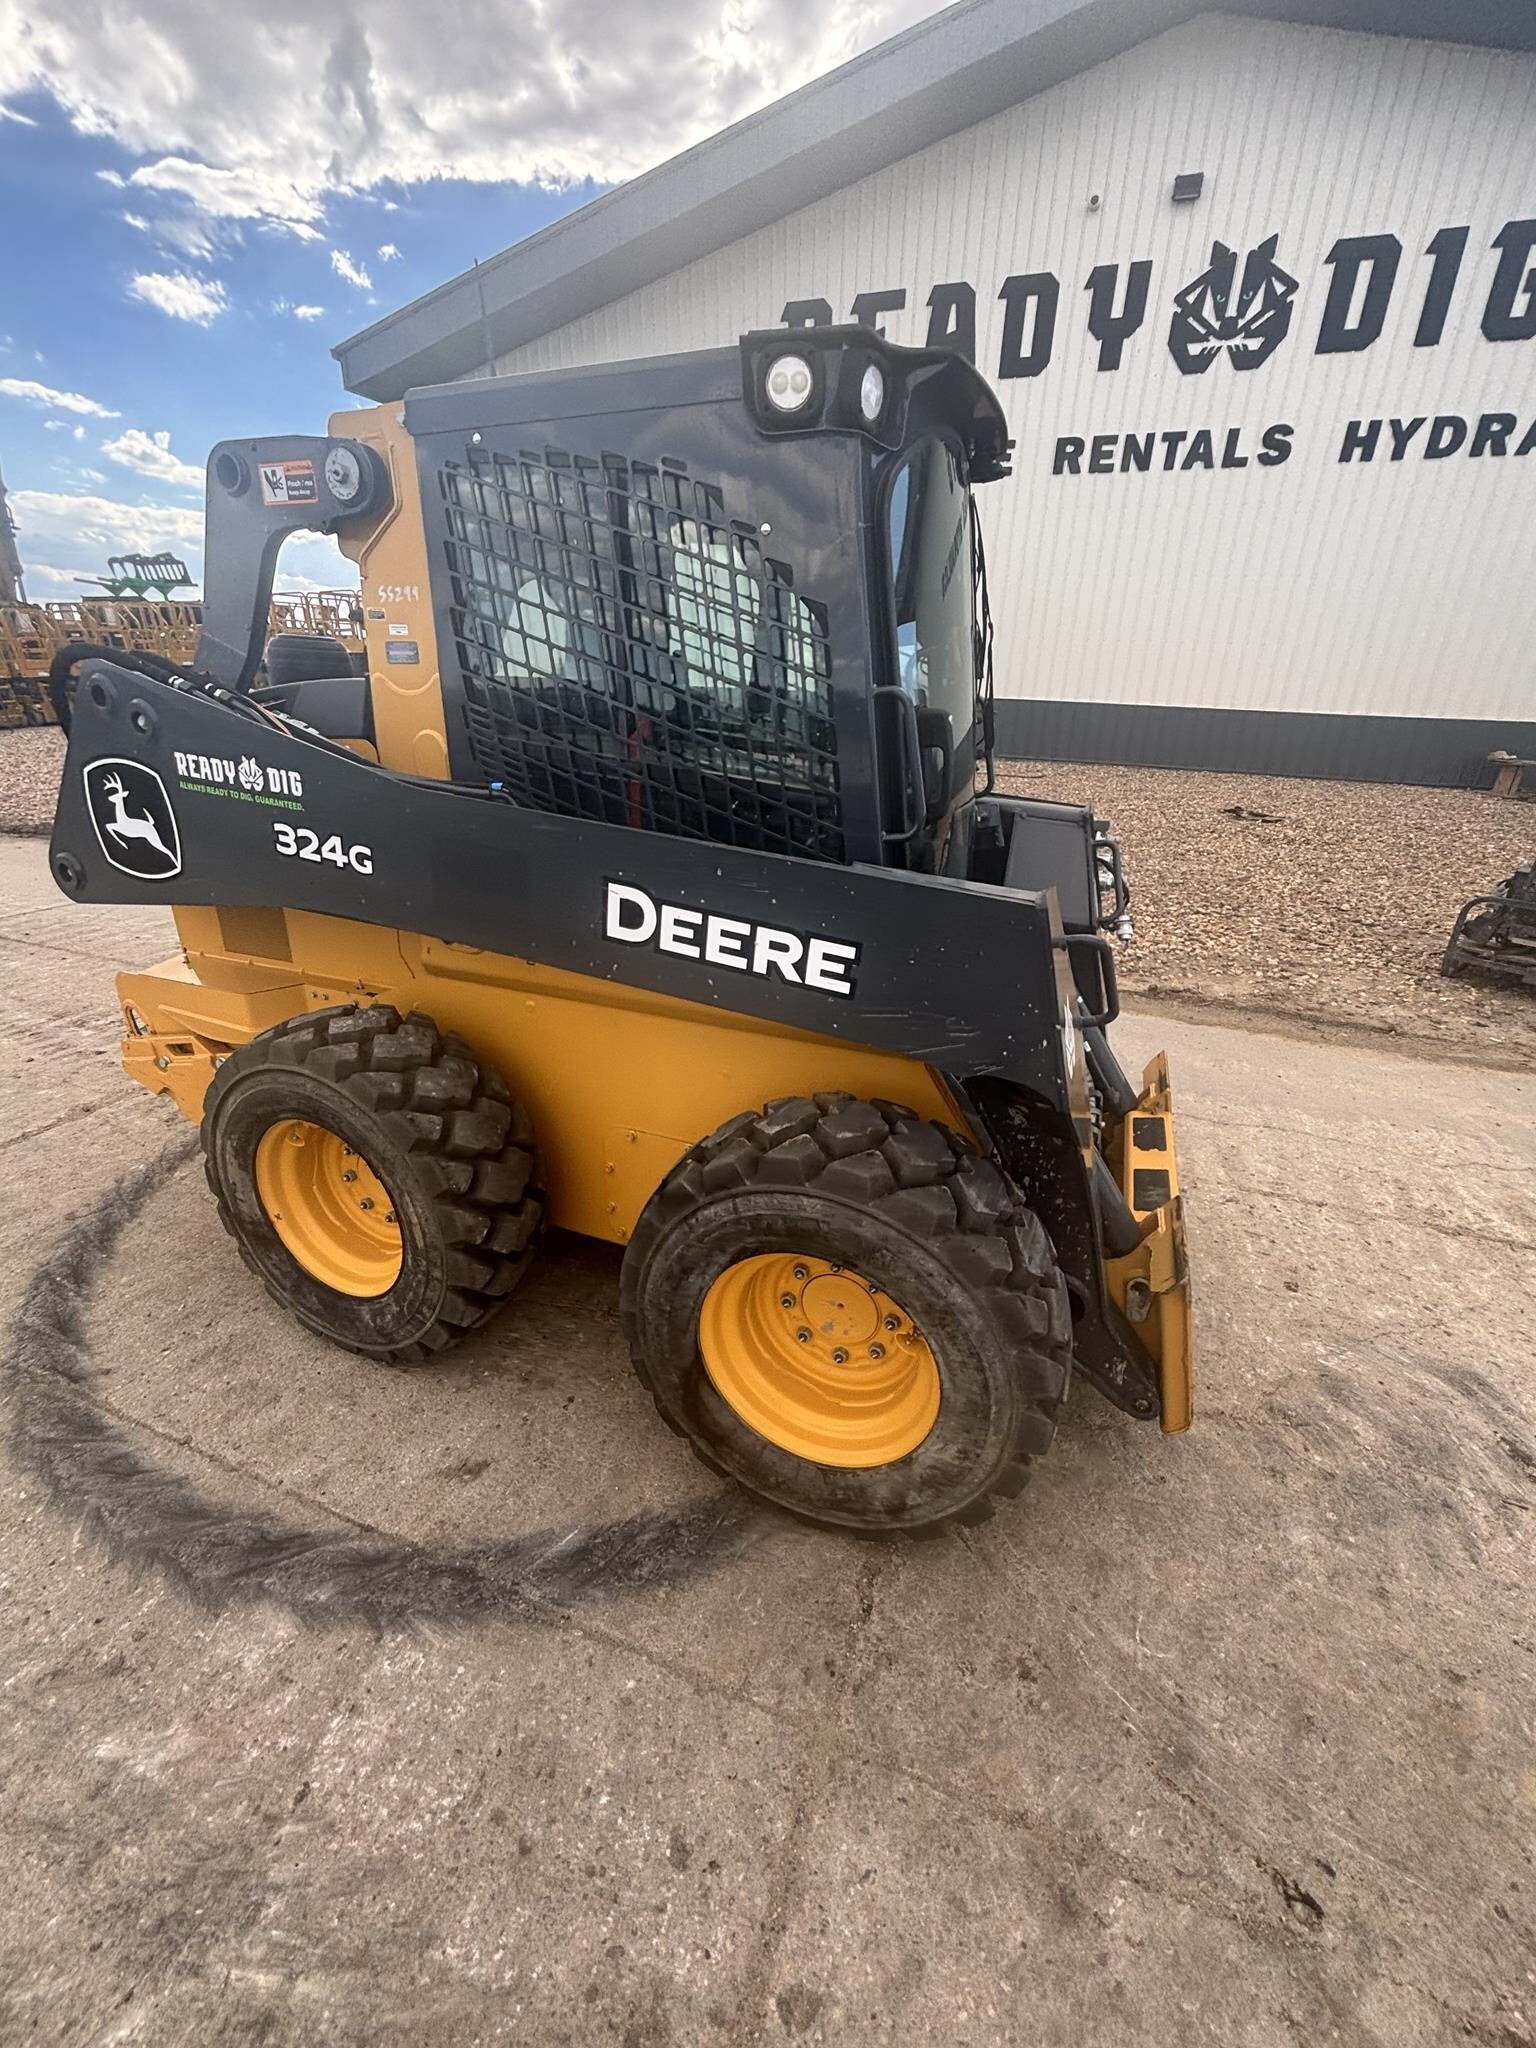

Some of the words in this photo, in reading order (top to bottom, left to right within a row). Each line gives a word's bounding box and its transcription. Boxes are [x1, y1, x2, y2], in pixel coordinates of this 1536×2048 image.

[780, 260, 1153, 379] ADY
[1053, 423, 1294, 475] RENTALS
[174, 752, 236, 785] READY
[266, 767, 303, 797] DIG
[179, 781, 206, 793] ALWAYS
[206, 786, 229, 797] READY
[230, 789, 239, 799] TO
[273, 822, 374, 875] 324G
[606, 882, 857, 995] DEERE
